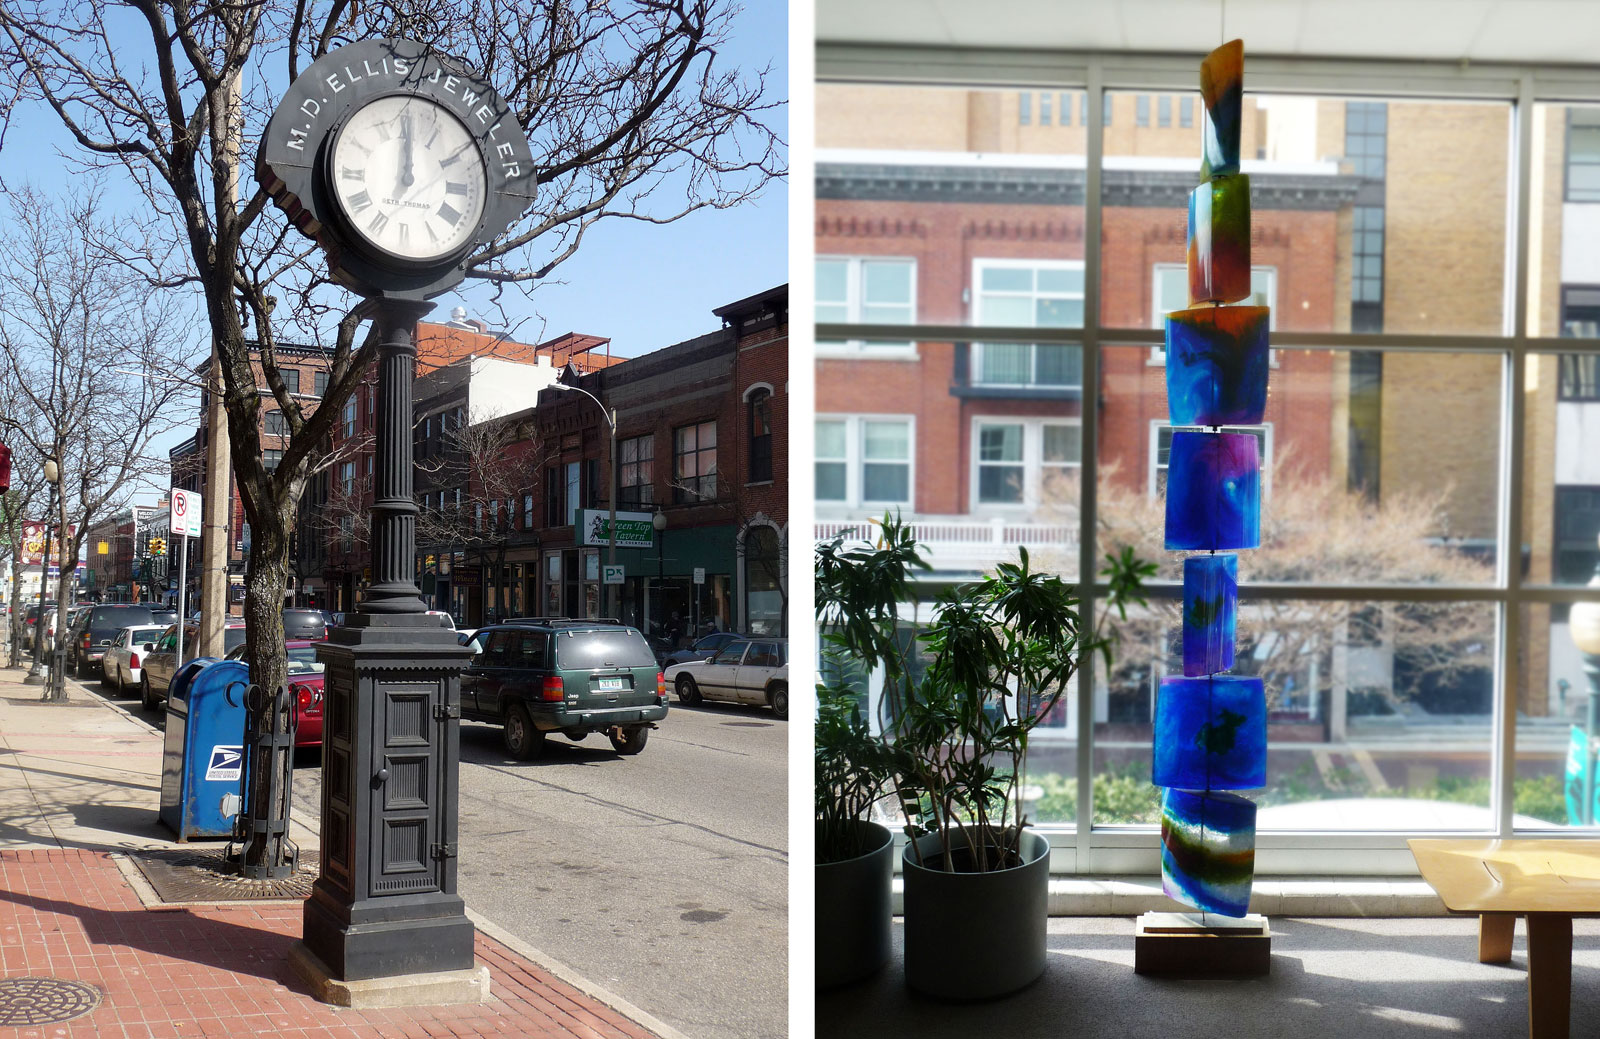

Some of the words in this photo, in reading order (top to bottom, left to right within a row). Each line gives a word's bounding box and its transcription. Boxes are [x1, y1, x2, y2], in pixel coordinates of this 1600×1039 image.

[326, 58, 409, 94] ELLIS
[427, 68, 521, 178] JEWELER
[403, 200, 431, 210] THOMAS
[607, 521, 633, 530] reen
[635, 522, 651, 534] Top
[615, 531, 645, 540] Tavern
[605, 568, 616, 581] P
